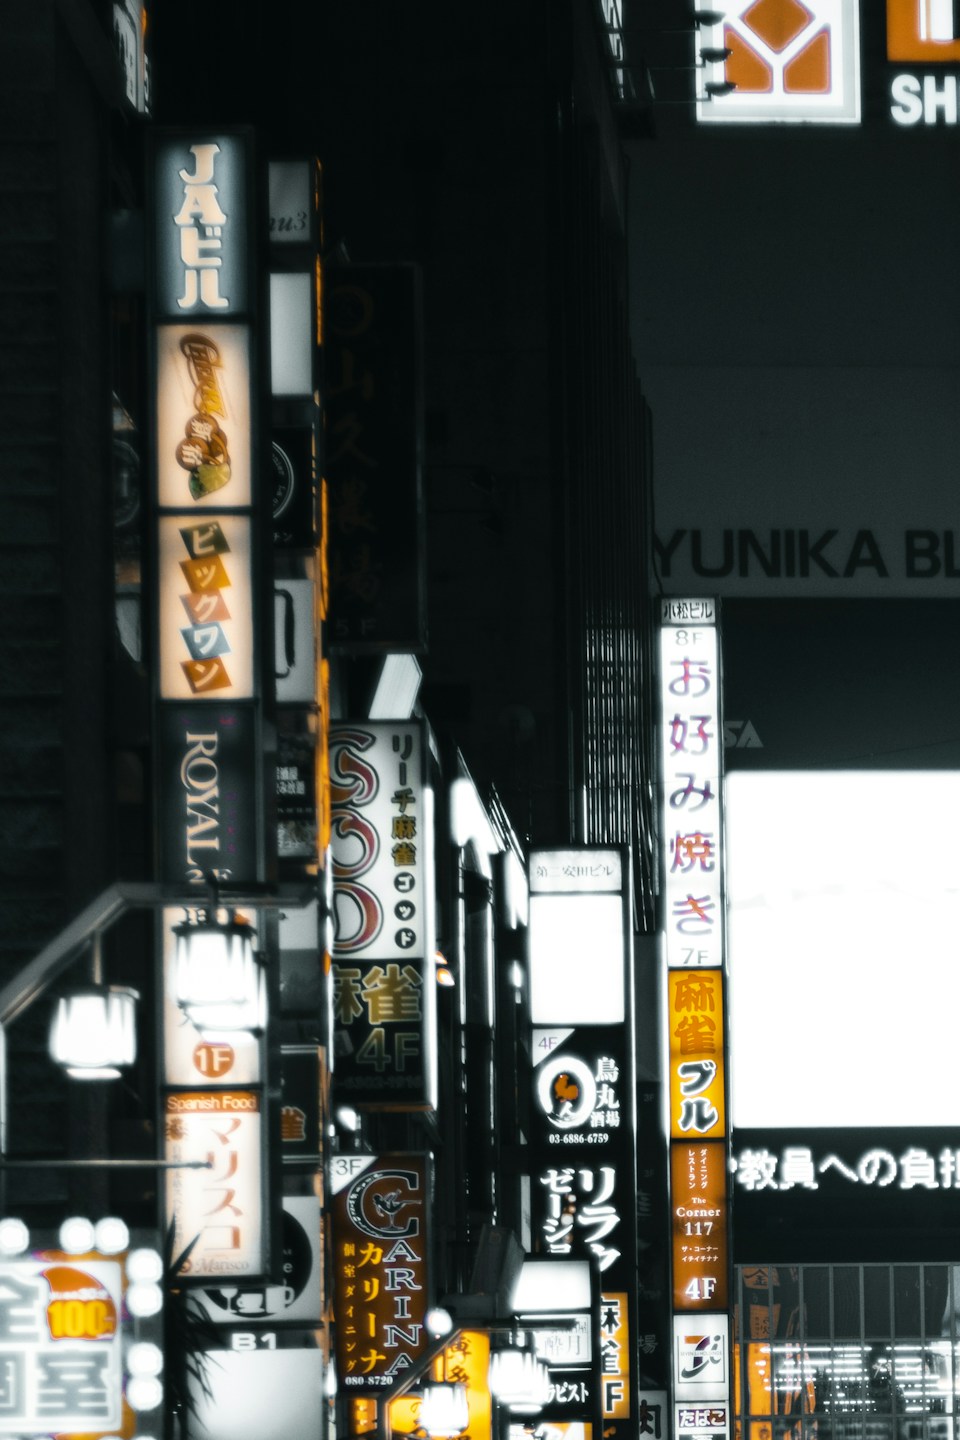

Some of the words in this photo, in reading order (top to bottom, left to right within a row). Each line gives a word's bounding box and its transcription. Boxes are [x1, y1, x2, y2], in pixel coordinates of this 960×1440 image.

[652, 529, 889, 579] YUNIKA
[663, 602, 713, 620] 小松ビル
[179, 731, 220, 866] ROYAL
[668, 656, 716, 936] お好み焼き
[680, 947, 709, 964] 7F
[538, 1037, 558, 1050] 4F
[195, 1047, 231, 1071] 1F
[167, 1095, 221, 1111] Spanish
[221, 1095, 257, 1110] Food
[549, 1133, 609, 1144] 03-6886-6759
[336, 1159, 363, 1176] 3F
[688, 1149, 696, 1189] レストラン
[700, 1149, 708, 1189] ダイニング
[200, 1117, 244, 1250] マリスコ
[676, 1207, 721, 1218] Corner
[685, 1222, 713, 1236] 117
[195, 1257, 250, 1273] Marisco
[346, 1169, 423, 1376] CARINA
[685, 1277, 717, 1300] 4F
[343, 1243, 357, 1373] 個室ダイニング
[358, 1242, 387, 1375] カリーナ
[231, 1333, 277, 1350] B1
[679, 1409, 726, 1428] たばこ
